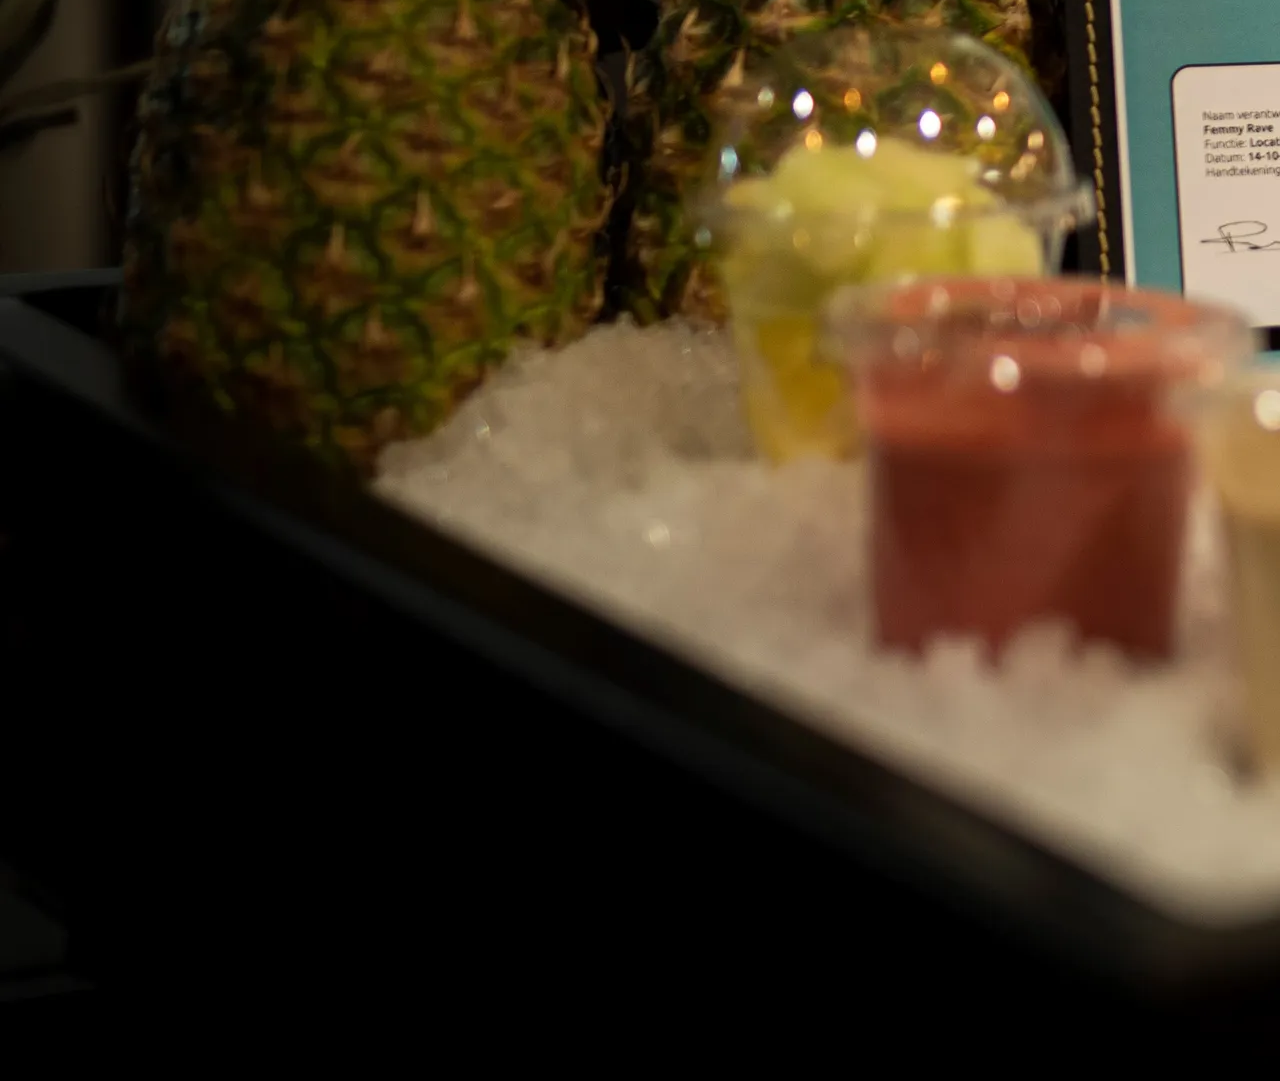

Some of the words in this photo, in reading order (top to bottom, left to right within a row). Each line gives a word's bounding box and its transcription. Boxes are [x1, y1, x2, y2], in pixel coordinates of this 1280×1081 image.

[1202, 111, 1234, 121] Naam
[1203, 125, 1244, 136] Femmy
[1247, 124, 1273, 133] Rave
[1204, 139, 1247, 149] Functie:
[1205, 153, 1245, 163] Datum:
